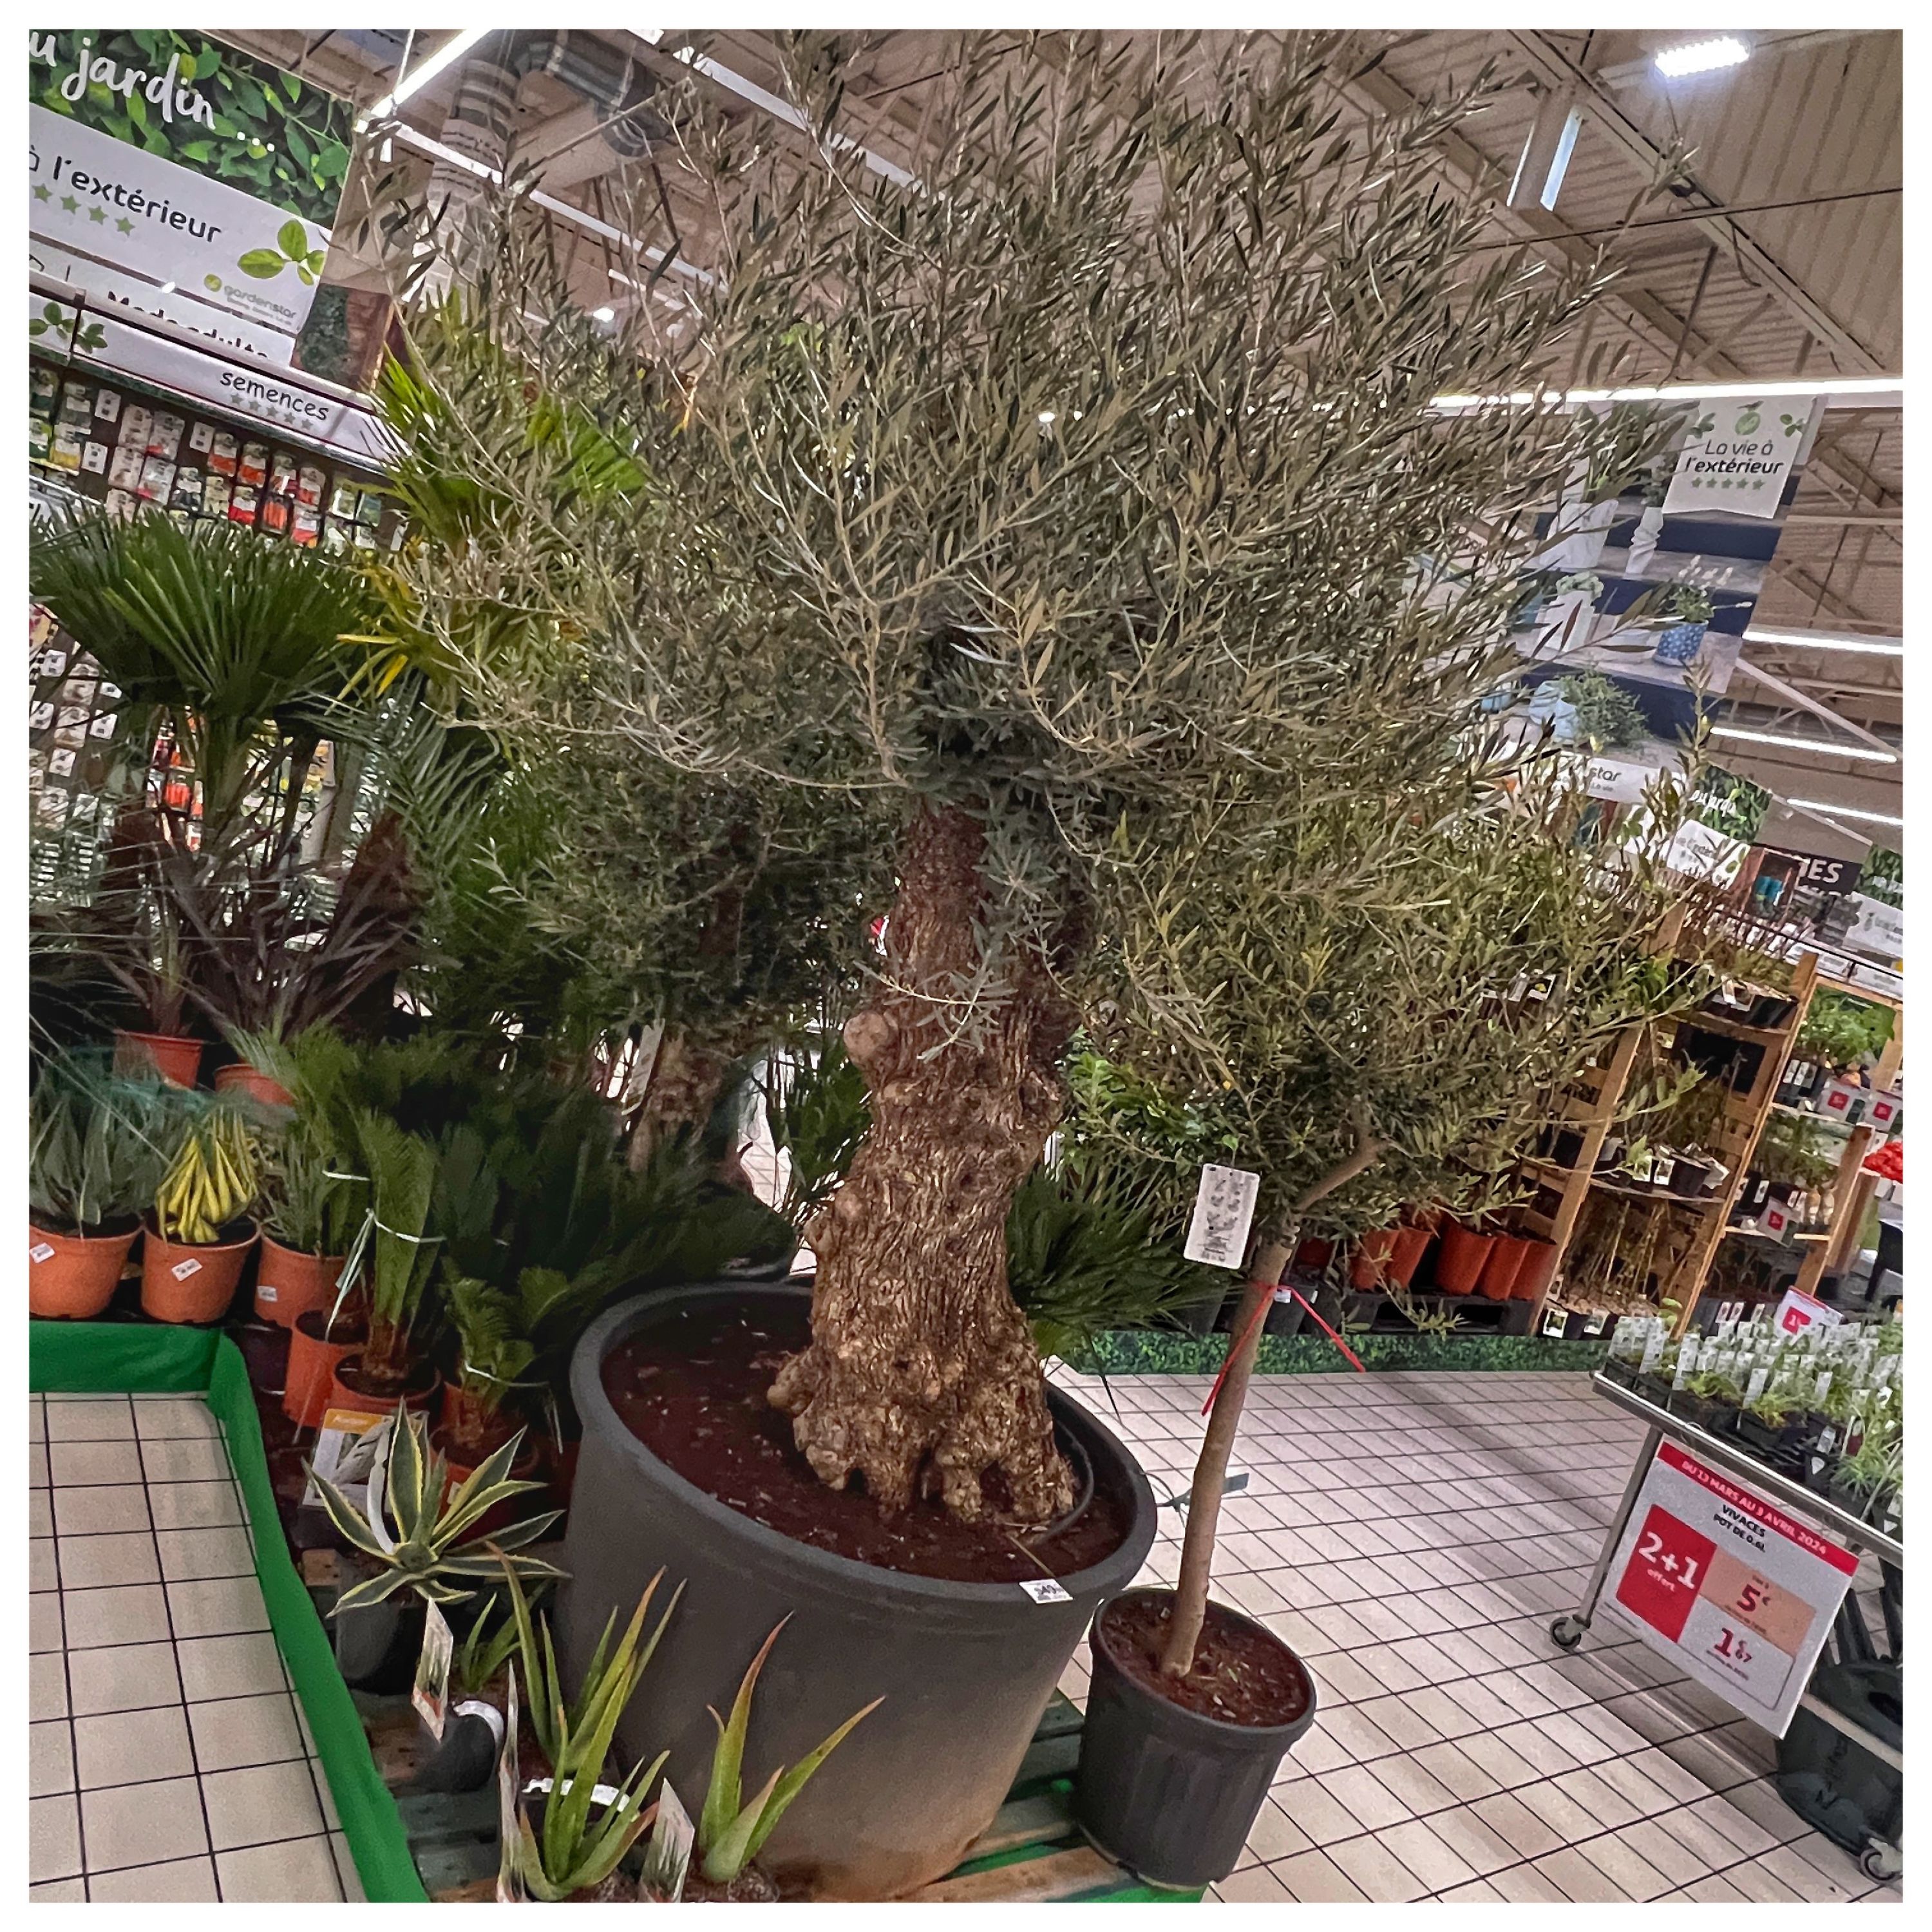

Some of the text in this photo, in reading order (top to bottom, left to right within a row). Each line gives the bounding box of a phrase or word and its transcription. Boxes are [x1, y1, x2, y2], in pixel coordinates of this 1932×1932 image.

[53, 156, 222, 242] l'extérieur
[220, 372, 329, 420] semences
[1705, 439, 1773, 455] La vie à
[1685, 457, 1784, 474] l'extérieur
[1590, 766, 1622, 781] star
[1682, 1460, 1697, 1475] DU
[1710, 1475, 1739, 1502] MARS
[1739, 1497, 1756, 1511] AU
[1764, 1512, 1796, 1537] AVRIL
[1797, 1531, 1827, 1555] 2024
[1722, 1504, 1766, 1537] VIVACES
[1713, 1513, 1733, 1530] POT
[1732, 1525, 1745, 1539] DE
[1638, 1531, 1698, 1589] 2+1
